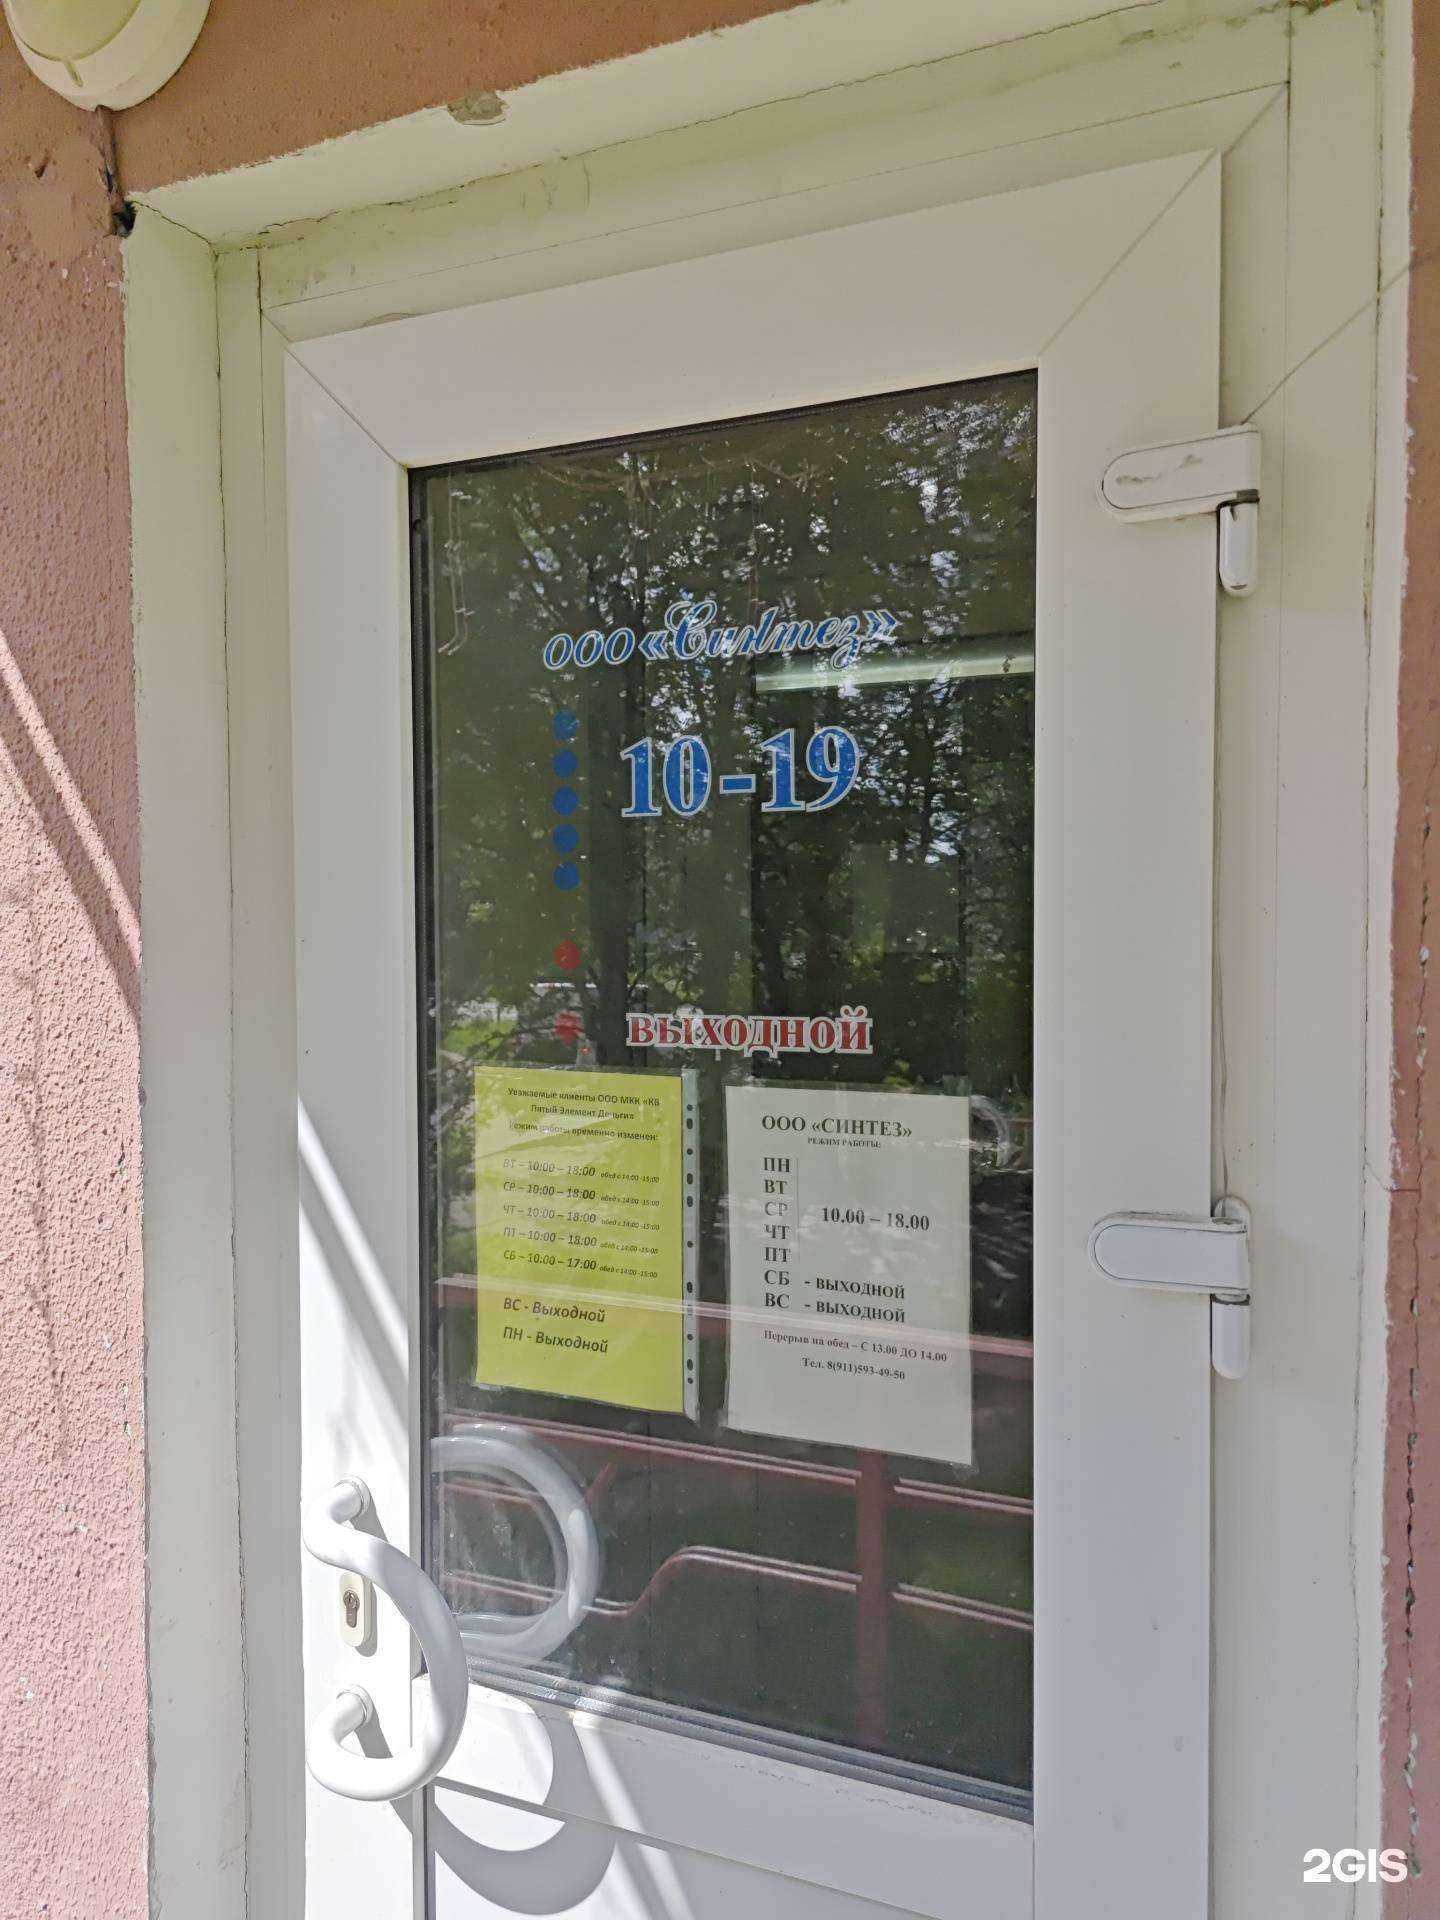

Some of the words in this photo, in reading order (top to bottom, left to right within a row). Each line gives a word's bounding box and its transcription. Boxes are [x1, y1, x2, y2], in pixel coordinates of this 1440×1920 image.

[625, 1005, 874, 1057] ВЫХОДНОЙ
[508, 1087, 557, 1099] Уважаемые
[559, 1093, 596, 1102] клиенты
[598, 1094, 618, 1104] ООО
[531, 1104, 558, 1114] Пятый
[560, 1106, 597, 1117] Элемент
[762, 1115, 806, 1131] ООО
[812, 1117, 912, 1137] «СИНТЕЗ»
[807, 1137, 840, 1147] РЕЖИМ
[528, 1161, 555, 1173] 10:00
[567, 1165, 596, 1177] 18:00
[763, 1157, 790, 1172] ПН
[503, 1181, 516, 1192] СР
[527, 1184, 555, 1196] 10:00
[567, 1188, 596, 1200] 18:00
[764, 1179, 787, 1194] ВТ
[527, 1207, 555, 1219] 10:00
[567, 1211, 596, 1223] 18:00
[764, 1201, 788, 1216] СР
[822, 1207, 865, 1224] 10.00
[886, 1212, 930, 1231] 18.00
[503, 1227, 516, 1238] ПТ
[528, 1230, 556, 1243] 10:00
[568, 1234, 597, 1247] 18:00
[764, 1224, 789, 1239] ЧТ
[503, 1249, 516, 1261] СБ
[527, 1253, 556, 1265] 10:00
[567, 1258, 597, 1271] 17:00
[764, 1247, 791, 1262] ПТ
[764, 1270, 790, 1285] СБ
[816, 1277, 905, 1299] ВЫХОДНОЙ
[503, 1297, 521, 1311] ВС
[532, 1301, 606, 1323] Выходной
[764, 1293, 790, 1309] ВС
[816, 1301, 905, 1323] ВЫХОДНОЙ
[503, 1327, 523, 1341] ПН
[536, 1331, 609, 1353] Выходной
[764, 1330, 810, 1344] Перерыв
[812, 1338, 824, 1346] на
[827, 1338, 850, 1349] обед
[872, 1343, 898, 1356] 13.00
[899, 1348, 918, 1358] ДО
[920, 1350, 948, 1362] 14.00
[802, 1357, 824, 1369] Тел.
[826, 1360, 906, 1380] 8(911)593-49-50
